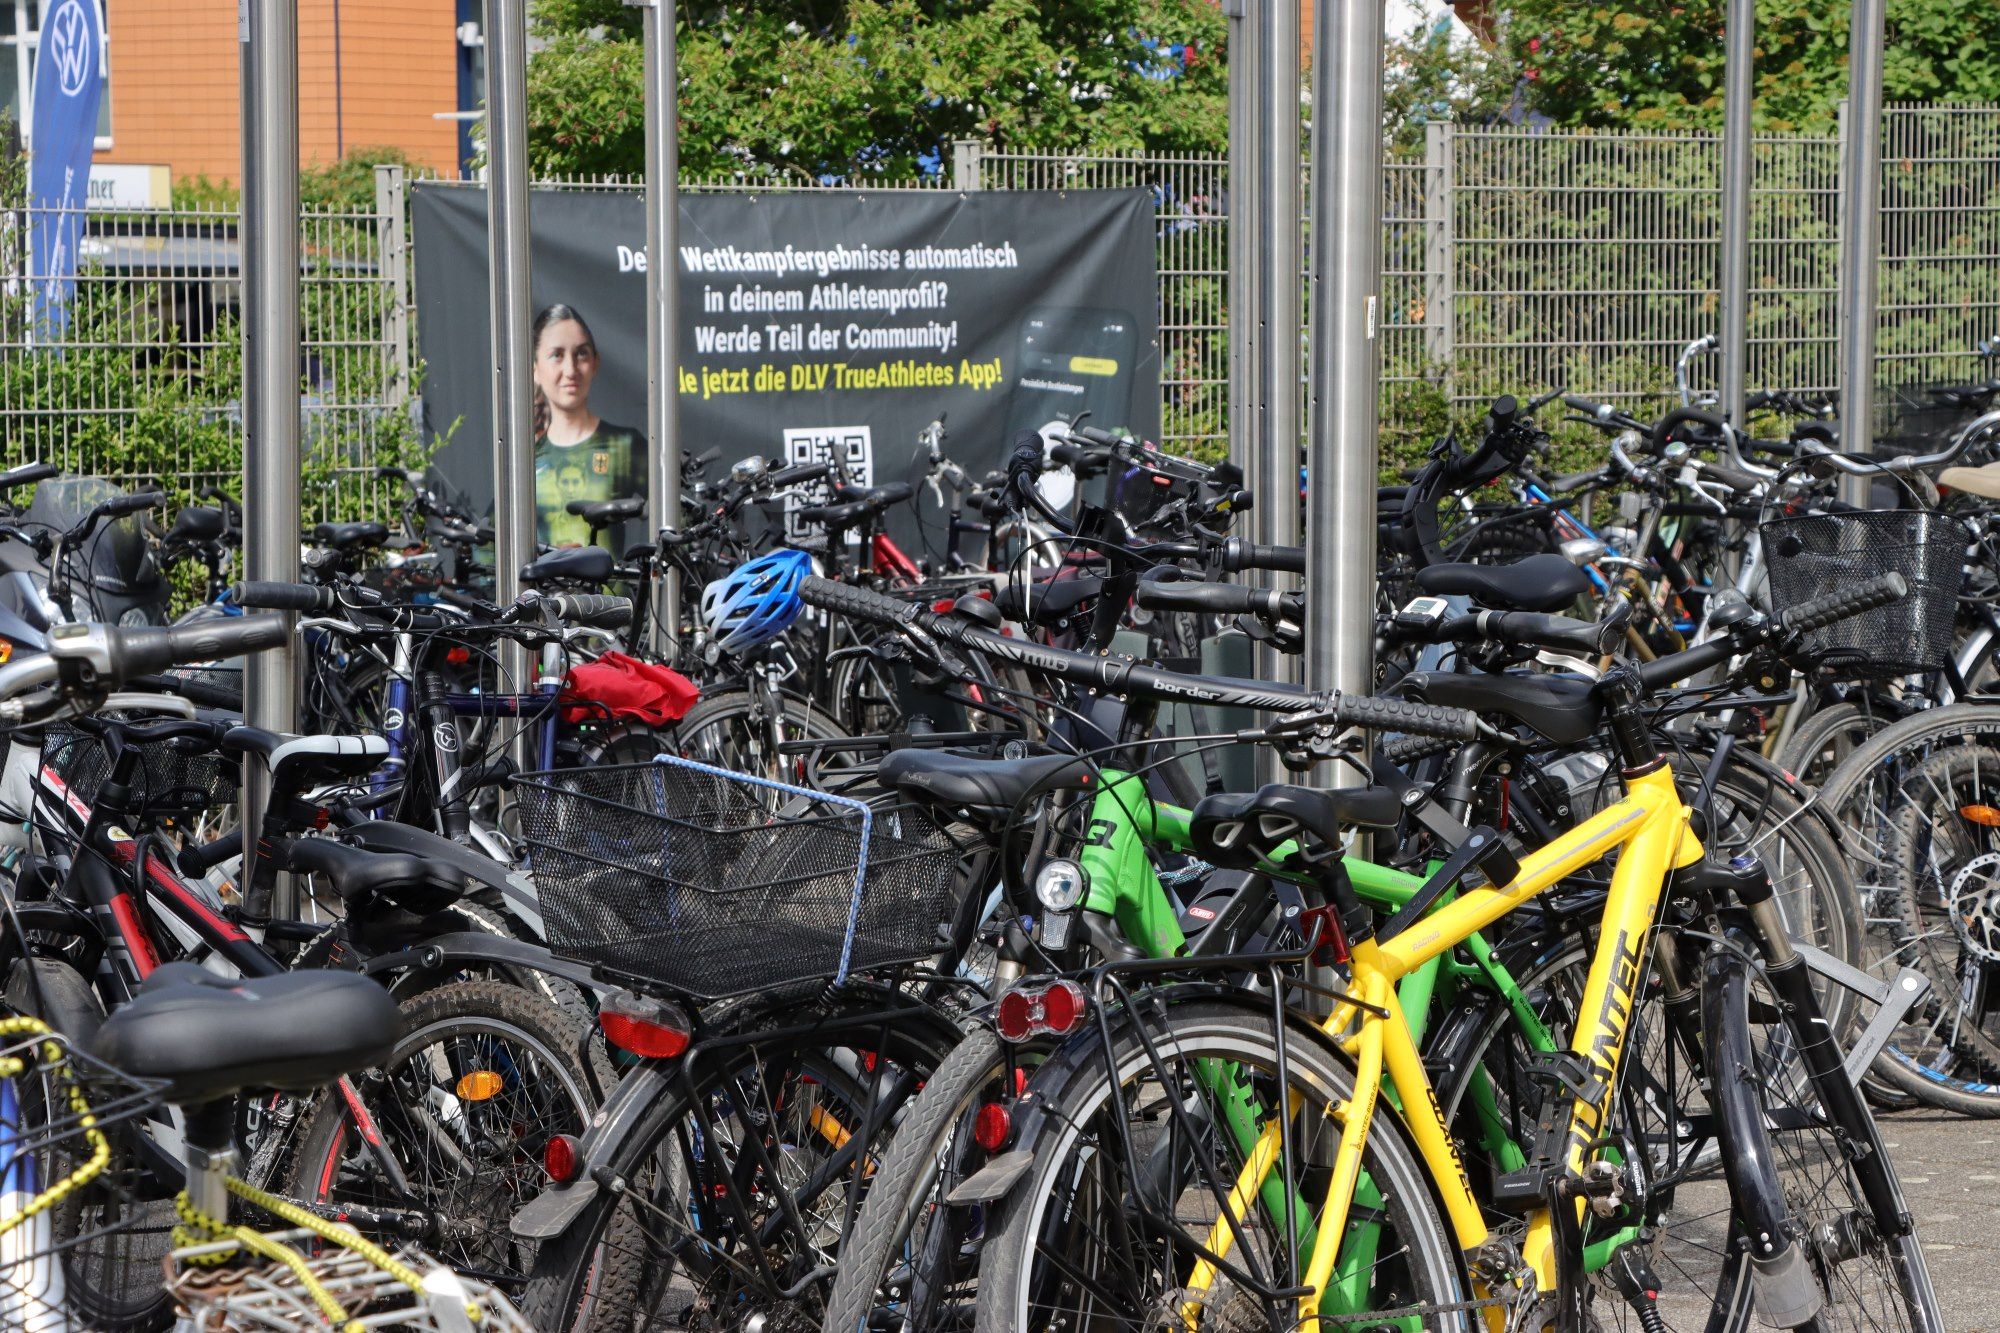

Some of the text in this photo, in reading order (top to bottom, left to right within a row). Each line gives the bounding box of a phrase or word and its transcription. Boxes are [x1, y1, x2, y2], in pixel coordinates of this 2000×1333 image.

[616, 241, 1018, 277] De Wettkampfergebnisse automatisch
[704, 281, 948, 314] in deinem Athletenprofil?
[695, 320, 958, 354] Werde Teil der Community!
[702, 366, 749, 399] jetzt
[754, 364, 786, 391] die
[790, 363, 830, 391] DLV
[833, 359, 954, 389] TrueAthletes
[958, 358, 1003, 389] App!
[1153, 679, 1221, 700] border
[1631, 1161, 1643, 1196] SHIMANO
